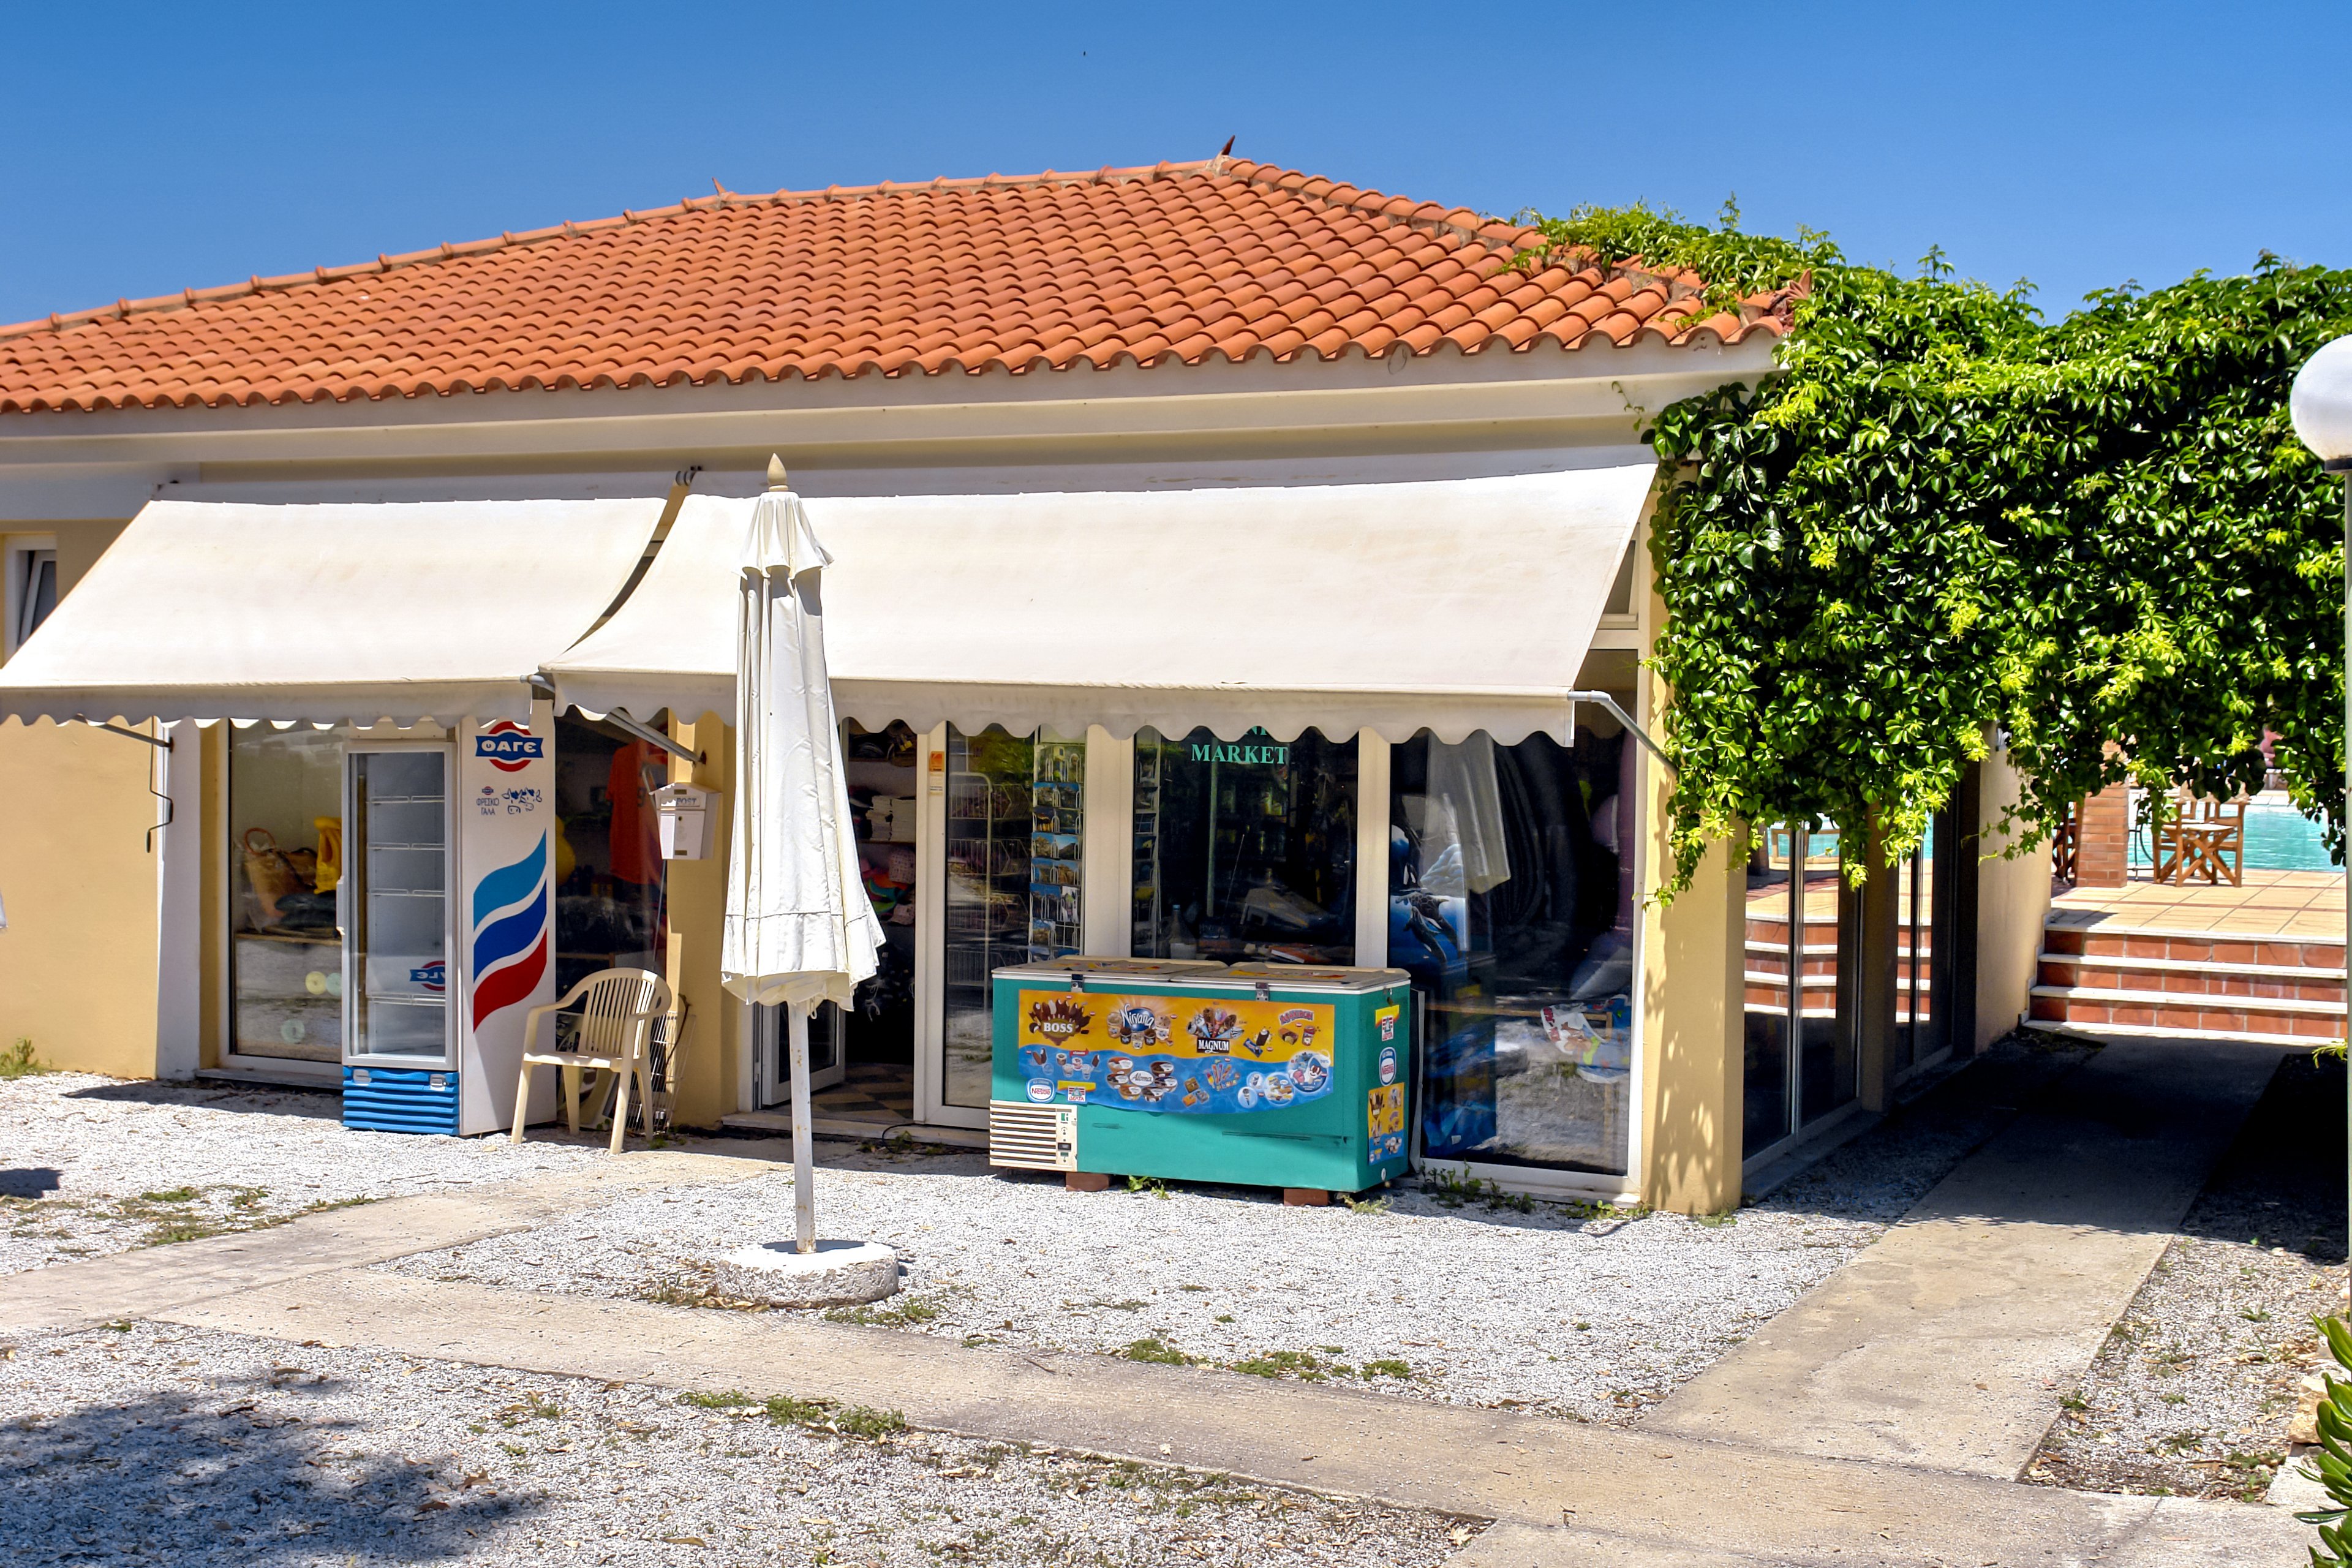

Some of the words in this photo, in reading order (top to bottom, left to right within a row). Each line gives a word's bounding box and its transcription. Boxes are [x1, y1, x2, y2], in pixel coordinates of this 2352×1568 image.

[1191, 744, 1288, 764] MARKET
[1119, 1003, 1155, 1029] Nirvana
[1044, 1022, 1073, 1033] BOSS
[1198, 1039, 1229, 1054] MAGNUM
